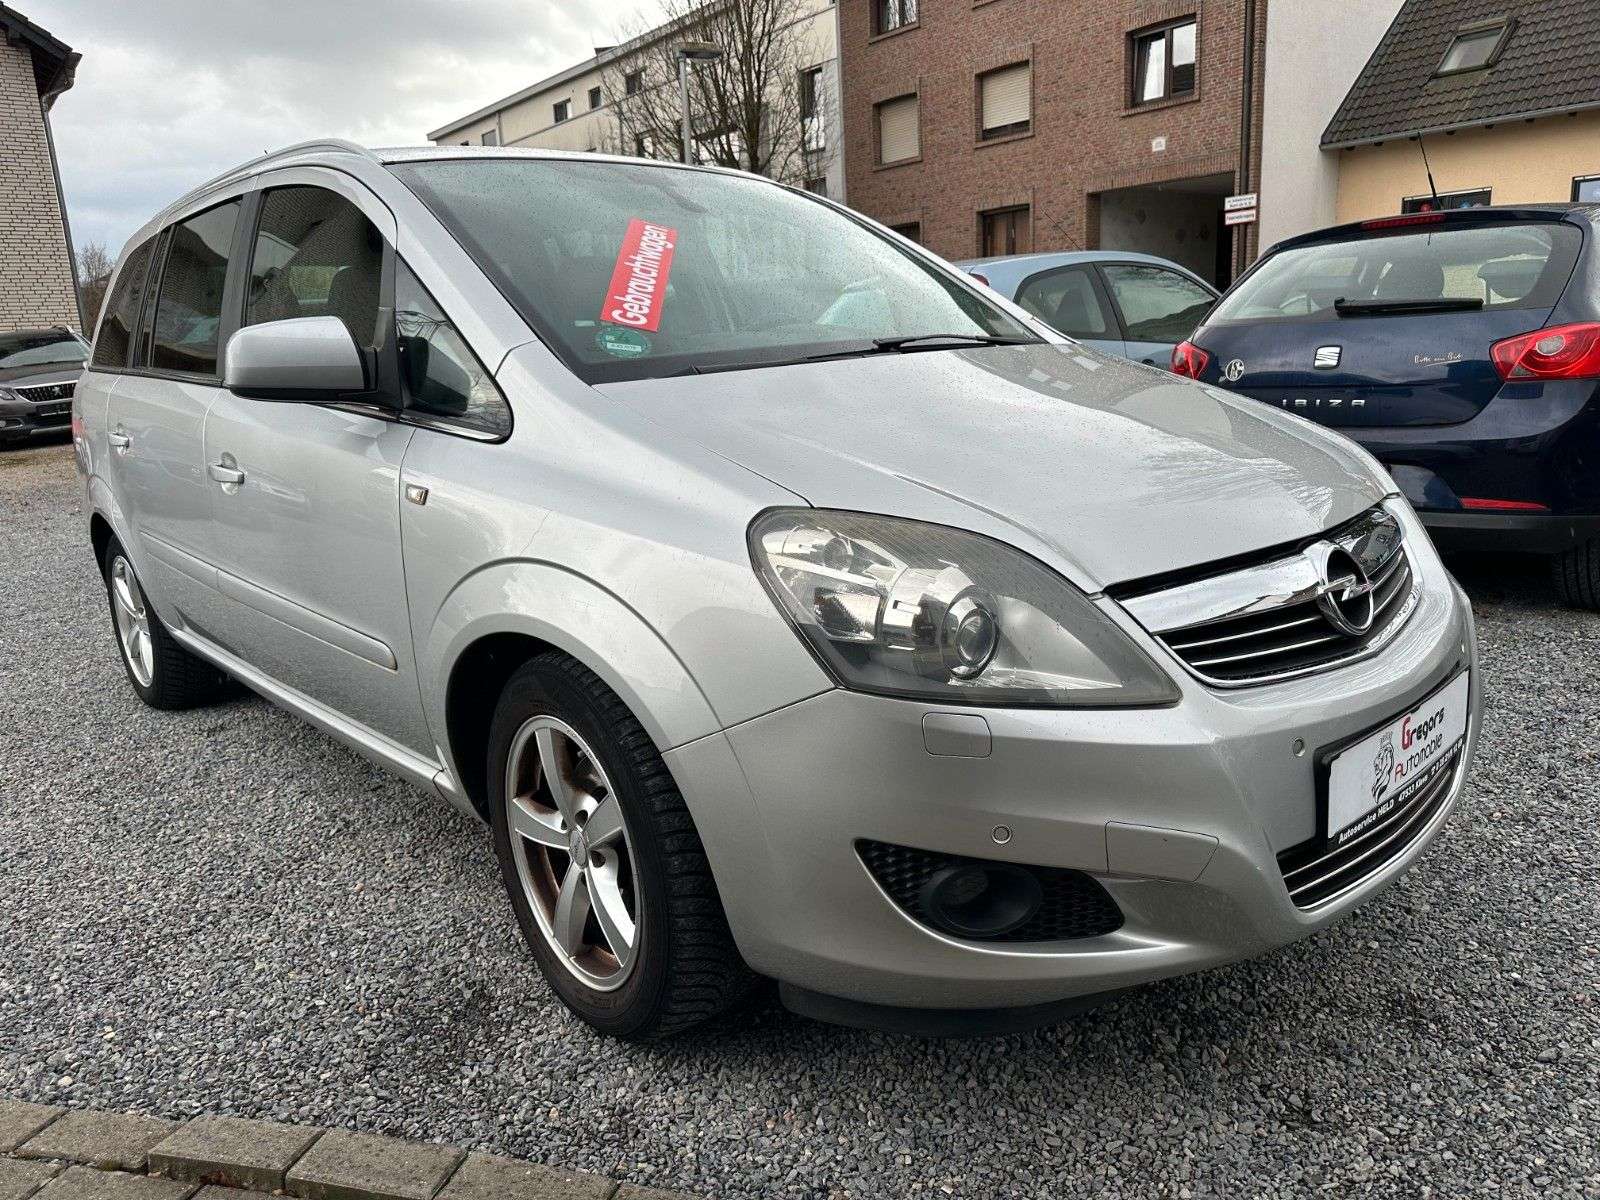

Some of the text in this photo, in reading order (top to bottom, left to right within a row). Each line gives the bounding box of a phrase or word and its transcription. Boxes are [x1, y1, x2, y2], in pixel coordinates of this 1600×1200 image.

[611, 224, 674, 325] Gebrauchtwagen
[1282, 399, 1366, 408] IBIZA
[1401, 707, 1445, 750] Gregors
[1394, 733, 1443, 783] Automobile
[1338, 813, 1377, 844] Autoservice
[1377, 799, 1395, 817] HELD
